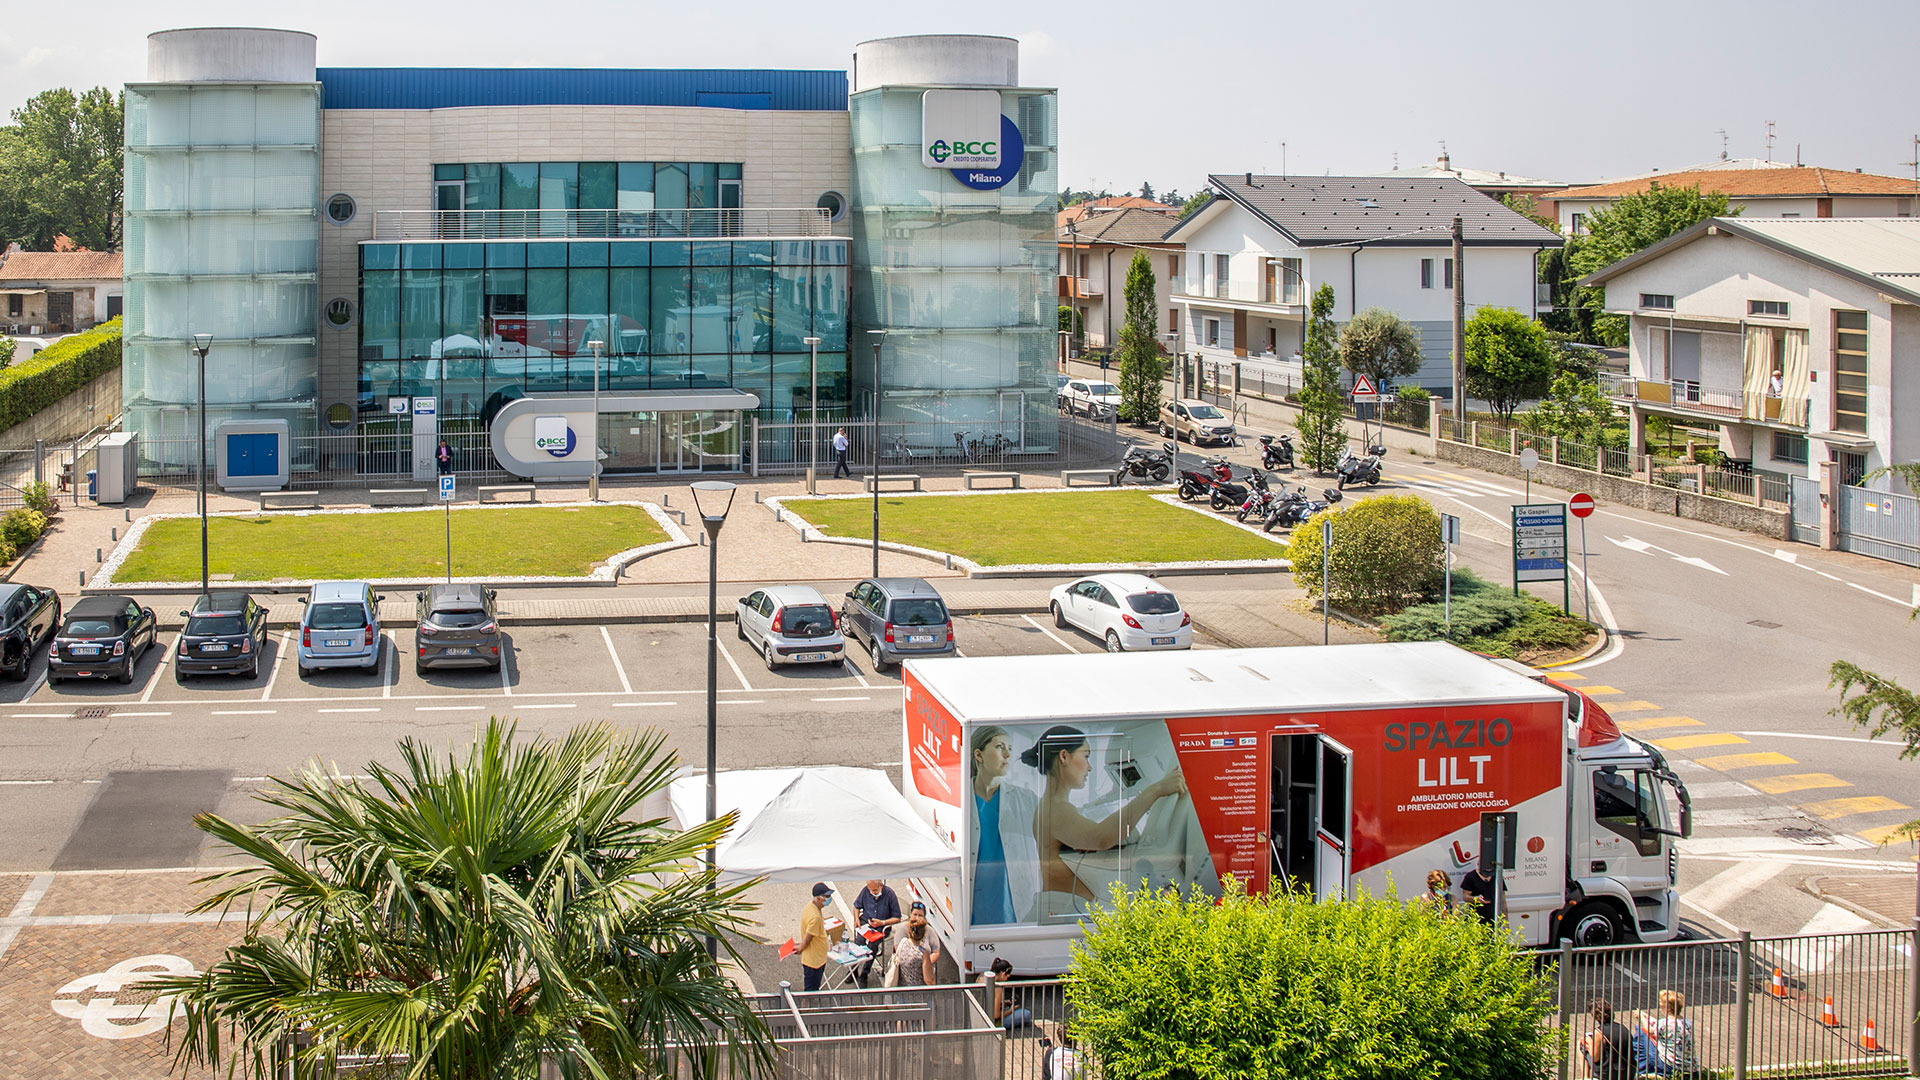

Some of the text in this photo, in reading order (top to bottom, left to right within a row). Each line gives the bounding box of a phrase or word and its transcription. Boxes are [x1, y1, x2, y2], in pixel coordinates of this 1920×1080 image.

[953, 142, 996, 154] BCC
[969, 173, 1002, 182] Milano
[444, 479, 452, 489] P
[916, 694, 948, 741] SPAZIO
[923, 723, 942, 760] LILT
[1384, 718, 1512, 752] SPAZIO
[1418, 755, 1491, 787] LILT
[1411, 791, 1494, 802] AMBULATORIO MOBILE
[1406, 802, 1458, 812] PREVENZIONE
[1460, 799, 1510, 809] ONCOLOGICA
